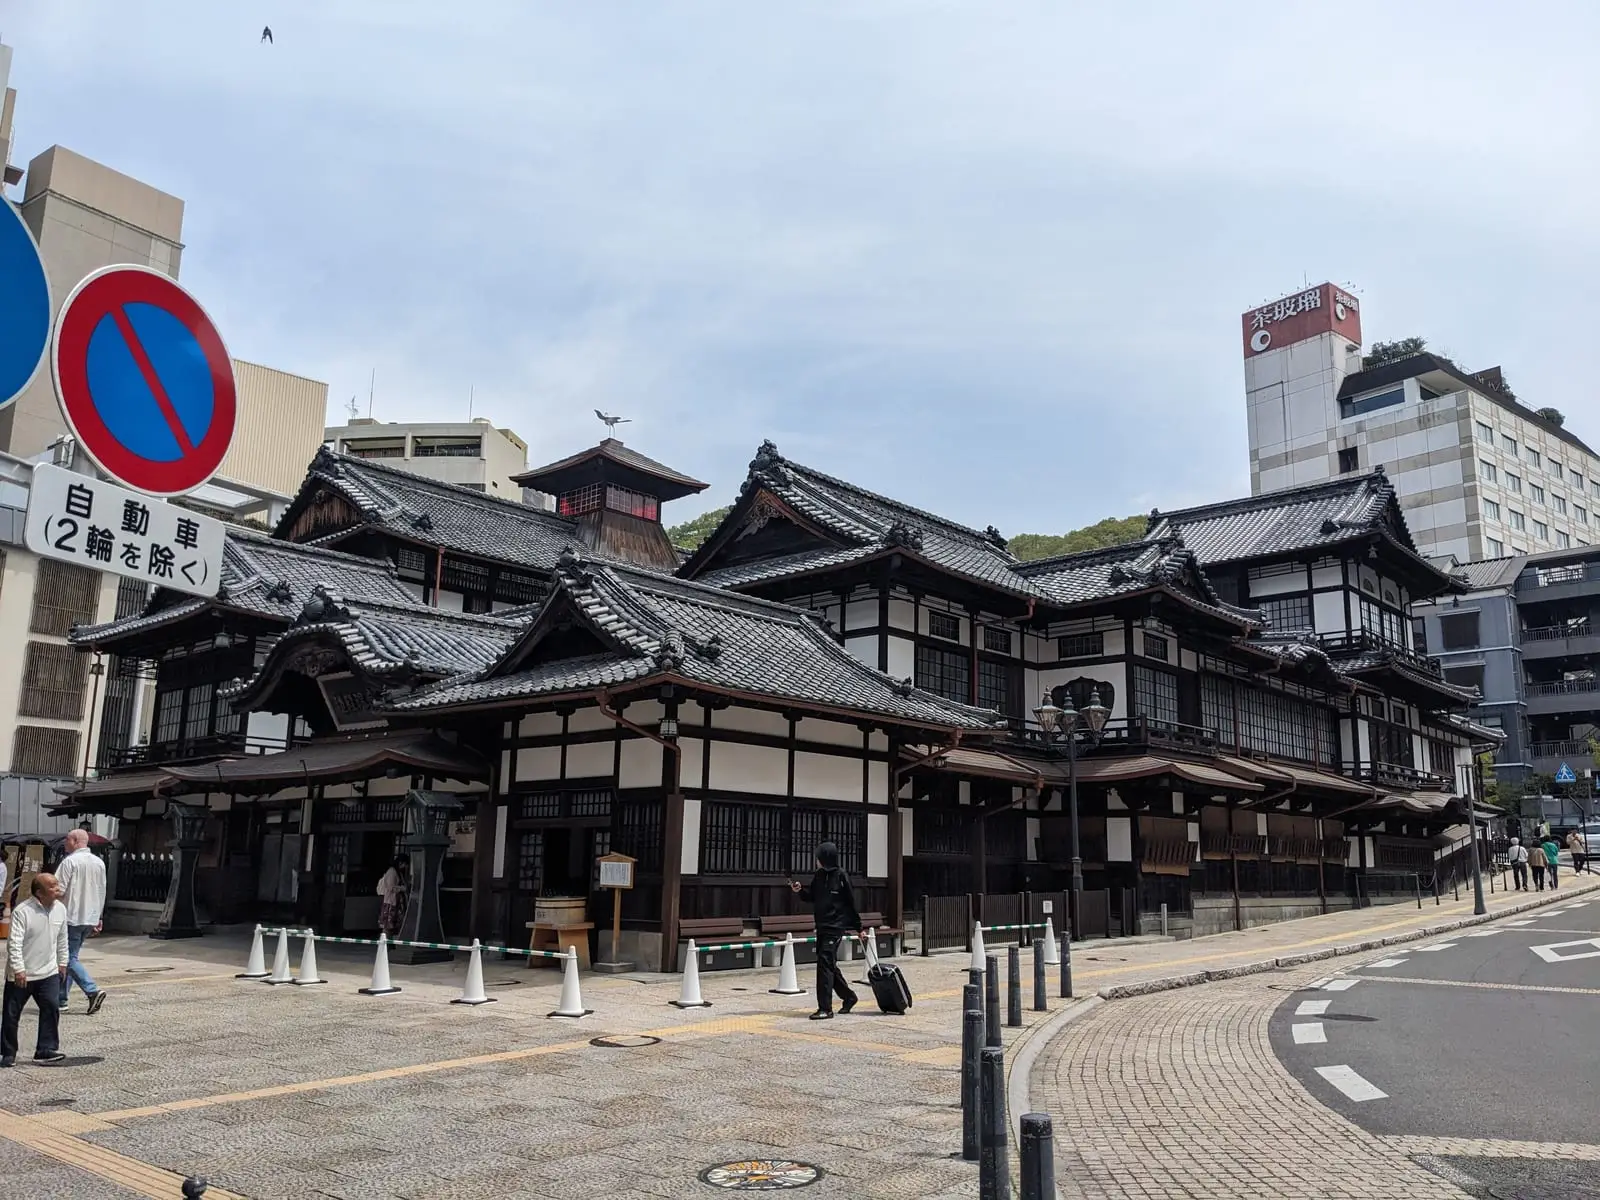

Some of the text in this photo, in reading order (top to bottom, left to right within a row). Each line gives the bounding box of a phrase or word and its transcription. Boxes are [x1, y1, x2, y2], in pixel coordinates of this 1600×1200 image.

[1251, 289, 1321, 330] 茶玻瑠
[44, 514, 208, 586] (2輪を除く)
[65, 483, 201, 550] 自動車
